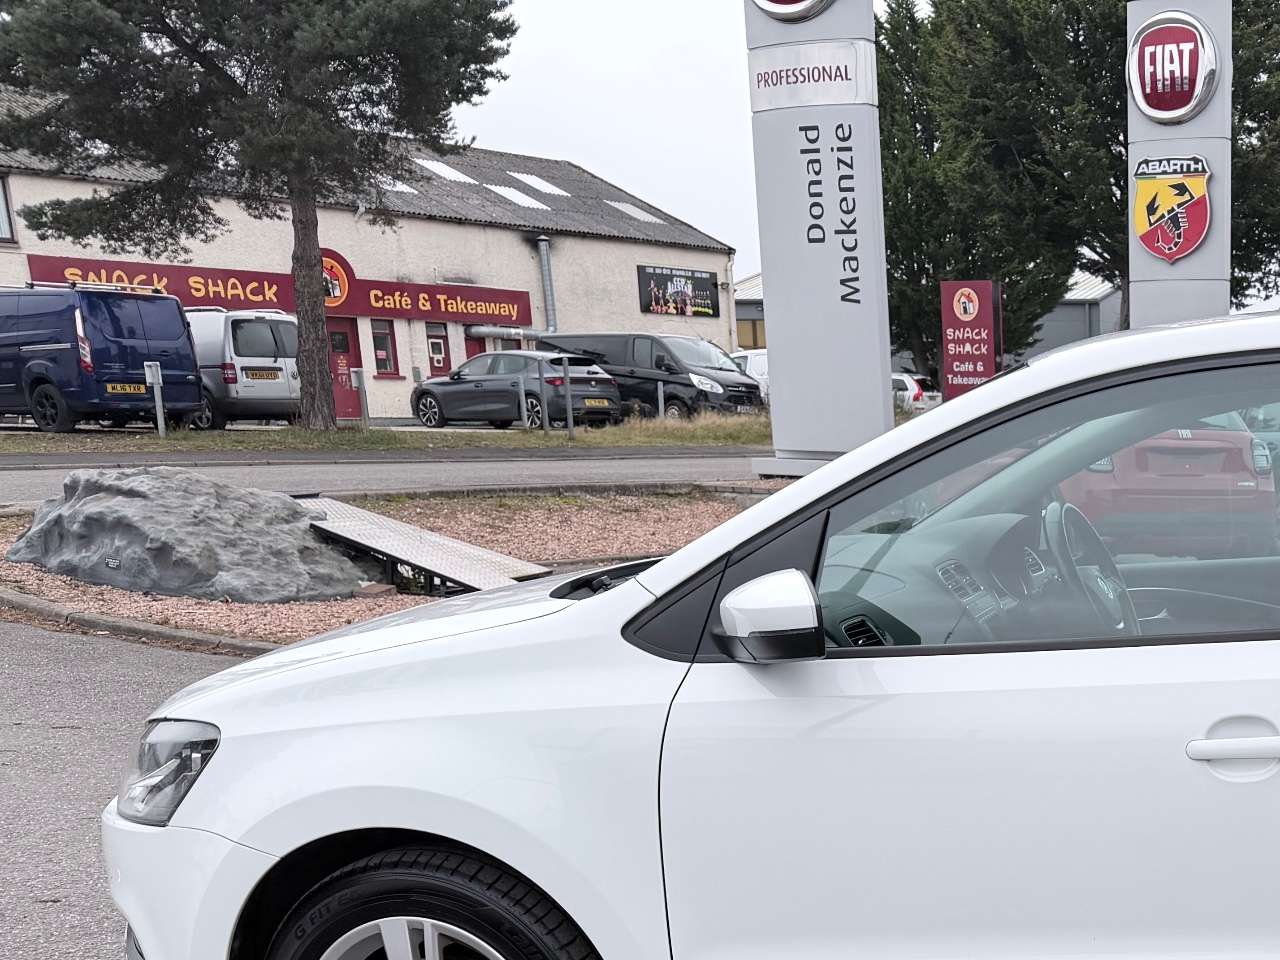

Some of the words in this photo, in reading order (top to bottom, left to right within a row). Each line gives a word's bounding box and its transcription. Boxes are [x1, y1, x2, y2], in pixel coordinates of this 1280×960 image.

[756, 64, 852, 89] PROFESSIONAL
[1143, 42, 1195, 93] FIAT
[1136, 159, 1203, 174] ABARTH
[798, 124, 826, 244] Donald
[830, 122, 861, 305] Mackenzie
[63, 267, 168, 294] SNACK
[188, 275, 279, 303] SHACK
[369, 289, 412, 311] Café
[418, 290, 431, 311] &
[439, 293, 518, 320] Takeaway
[946, 327, 988, 340] SNACK
[947, 342, 988, 355] SHACK
[953, 361, 974, 372] Café
[976, 361, 984, 372] &
